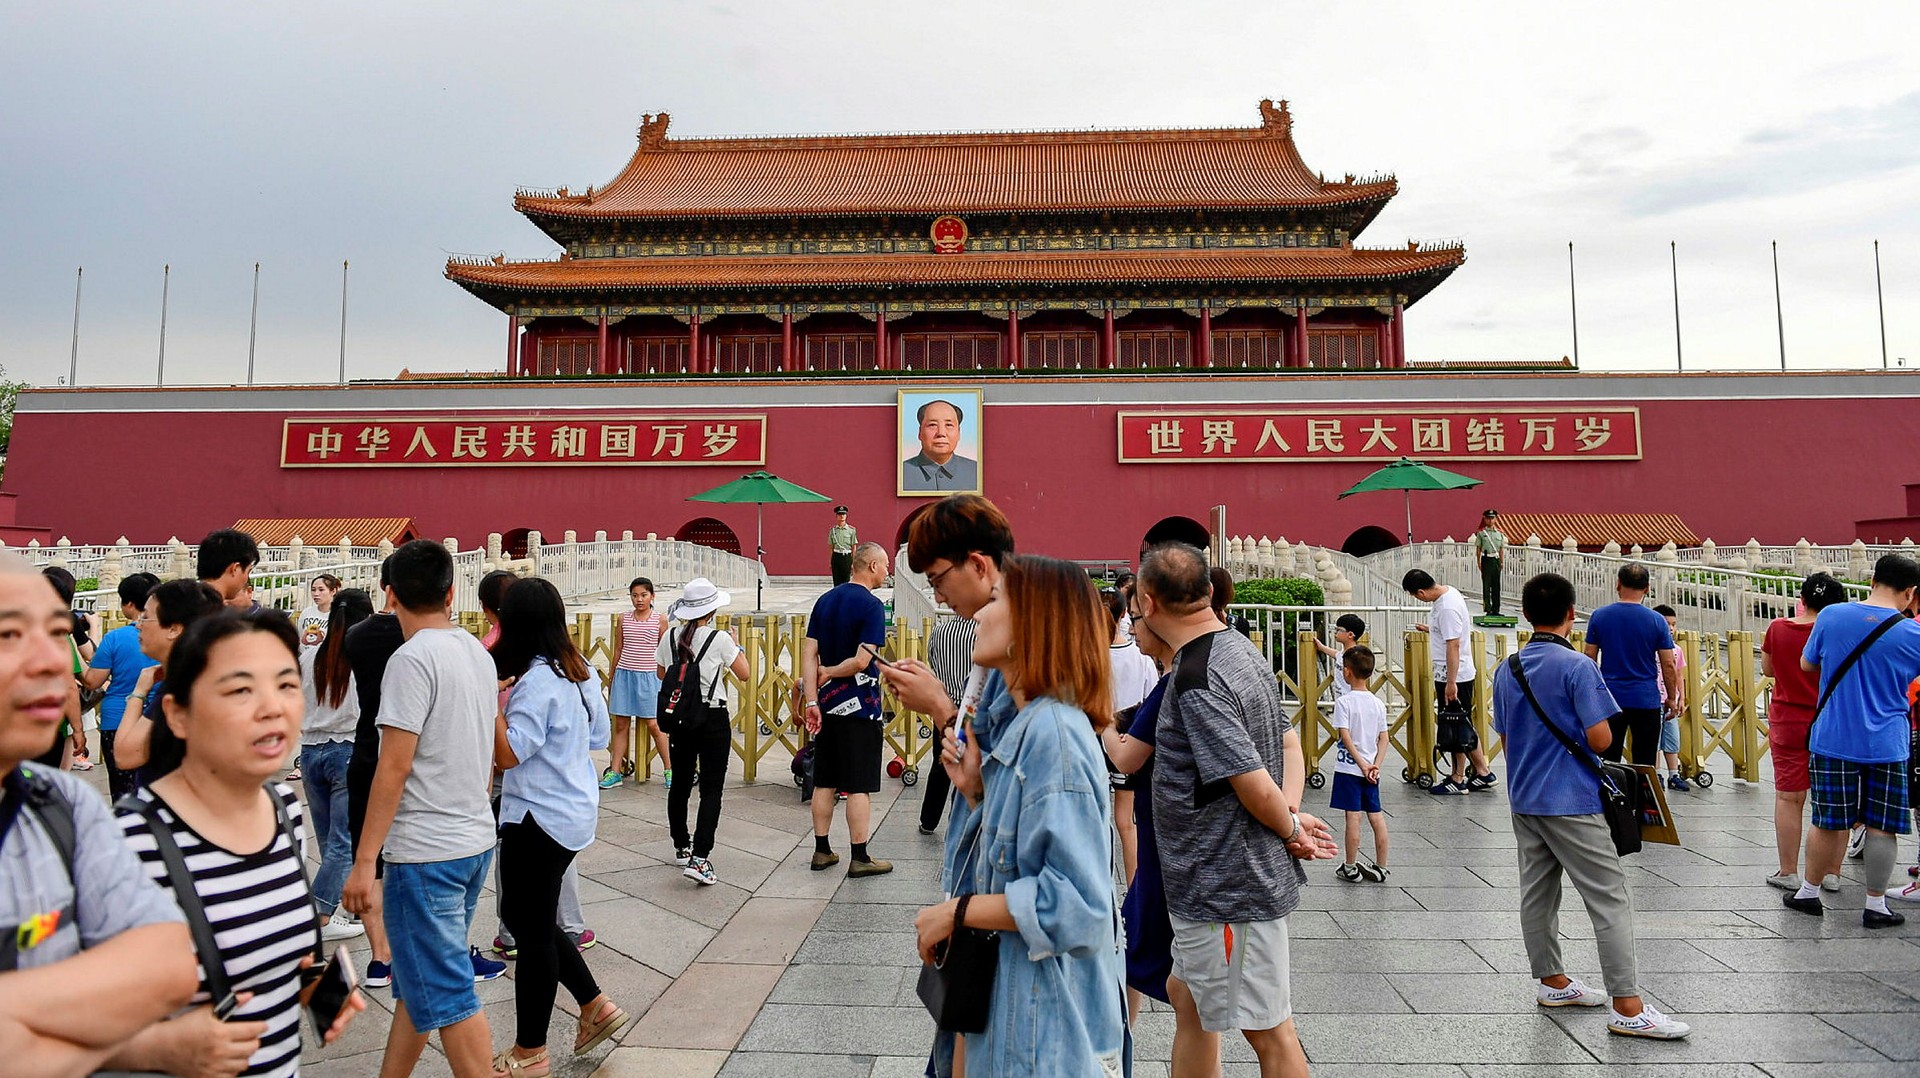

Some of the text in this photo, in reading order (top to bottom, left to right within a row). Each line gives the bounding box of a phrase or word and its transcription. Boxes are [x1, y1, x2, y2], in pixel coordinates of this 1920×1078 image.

[308, 425, 737, 458] 中华人民共和国万岁
[1148, 417, 1610, 453] 世界人民大团结万岁
